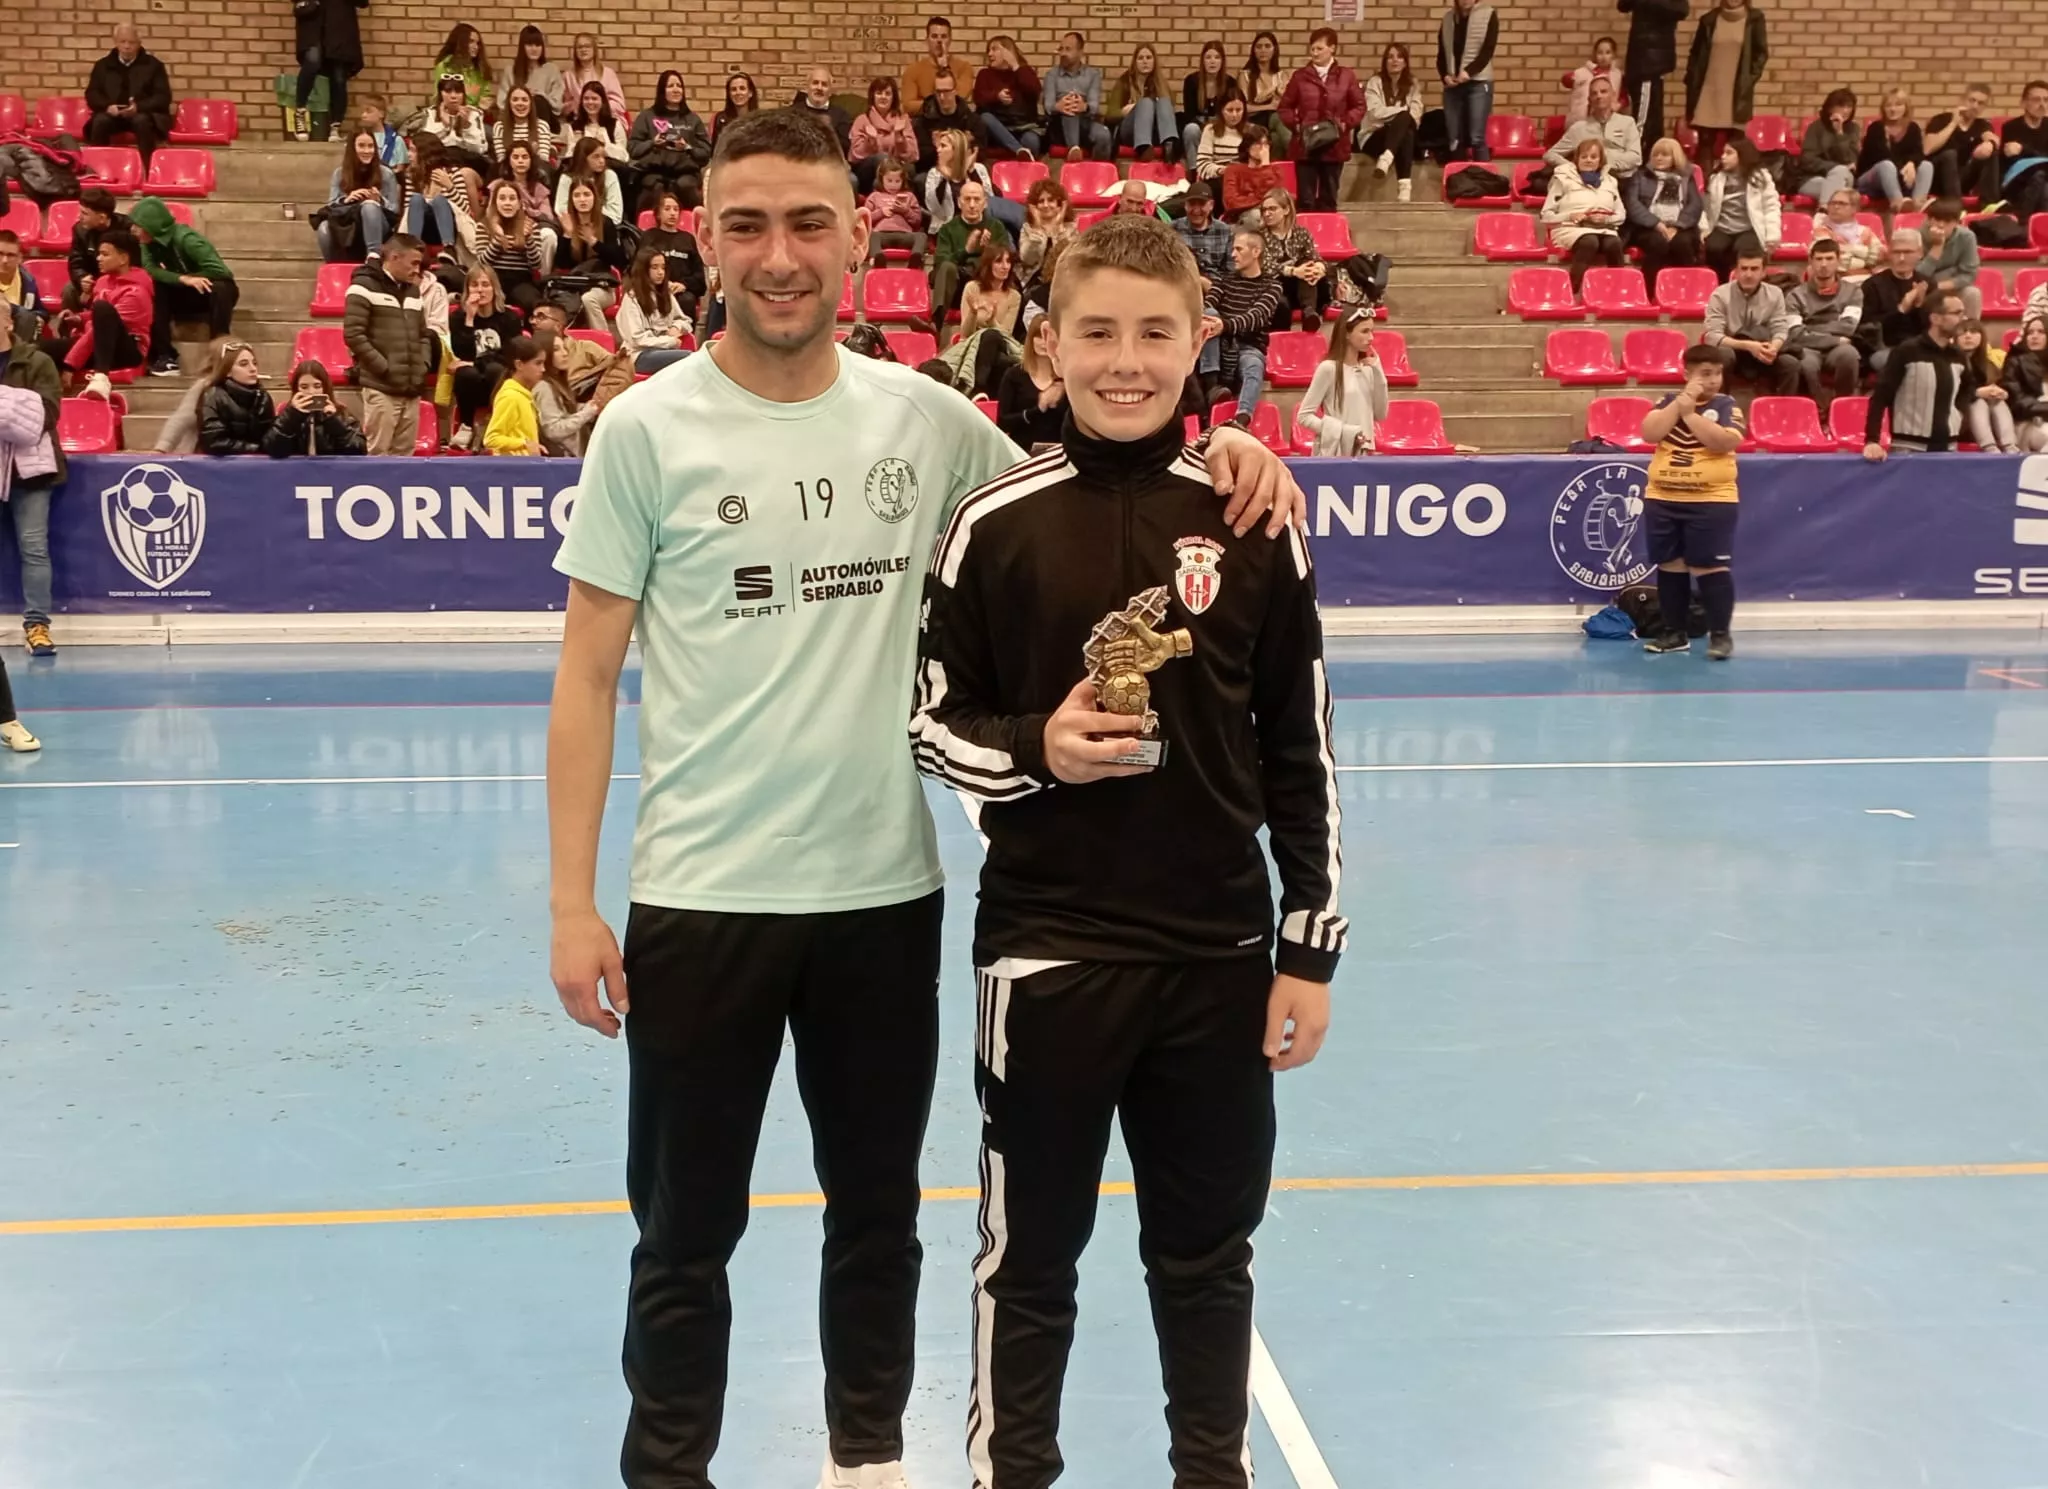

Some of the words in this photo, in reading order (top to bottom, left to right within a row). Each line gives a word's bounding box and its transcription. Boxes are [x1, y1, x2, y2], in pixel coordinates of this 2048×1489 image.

[1605, 467, 1628, 480] LA
[1658, 470, 1703, 478] SEAT
[794, 477, 834, 521] 19
[1300, 483, 1507, 537] NIGO
[801, 556, 911, 585] AUTOMÓVILES
[801, 579, 884, 603] SERRABLO
[724, 604, 786, 619] SEAT
